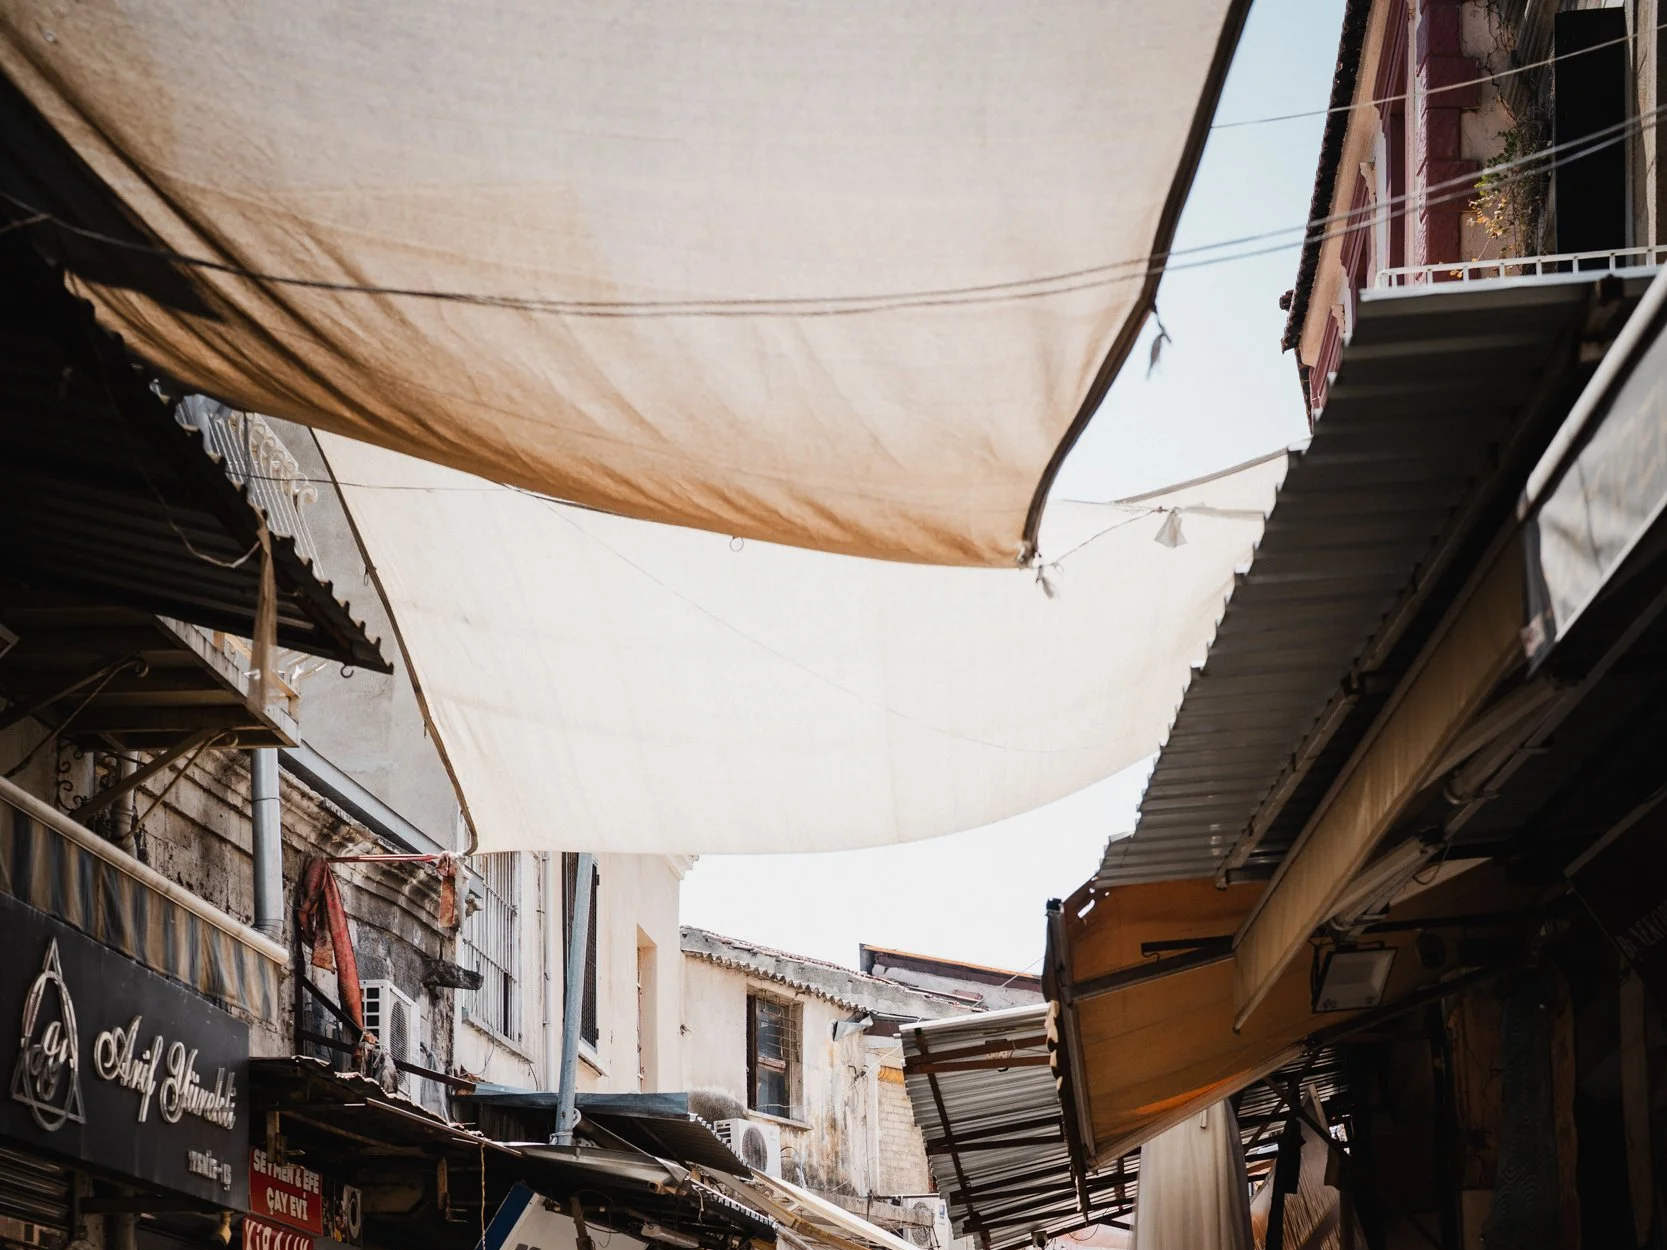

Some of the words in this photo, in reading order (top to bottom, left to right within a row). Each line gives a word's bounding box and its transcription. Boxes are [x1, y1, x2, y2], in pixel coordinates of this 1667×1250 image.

[303, 1170, 320, 1195] EFE
[266, 1187, 289, 1215] ÇAY
[290, 1191, 308, 1221] EVİ
